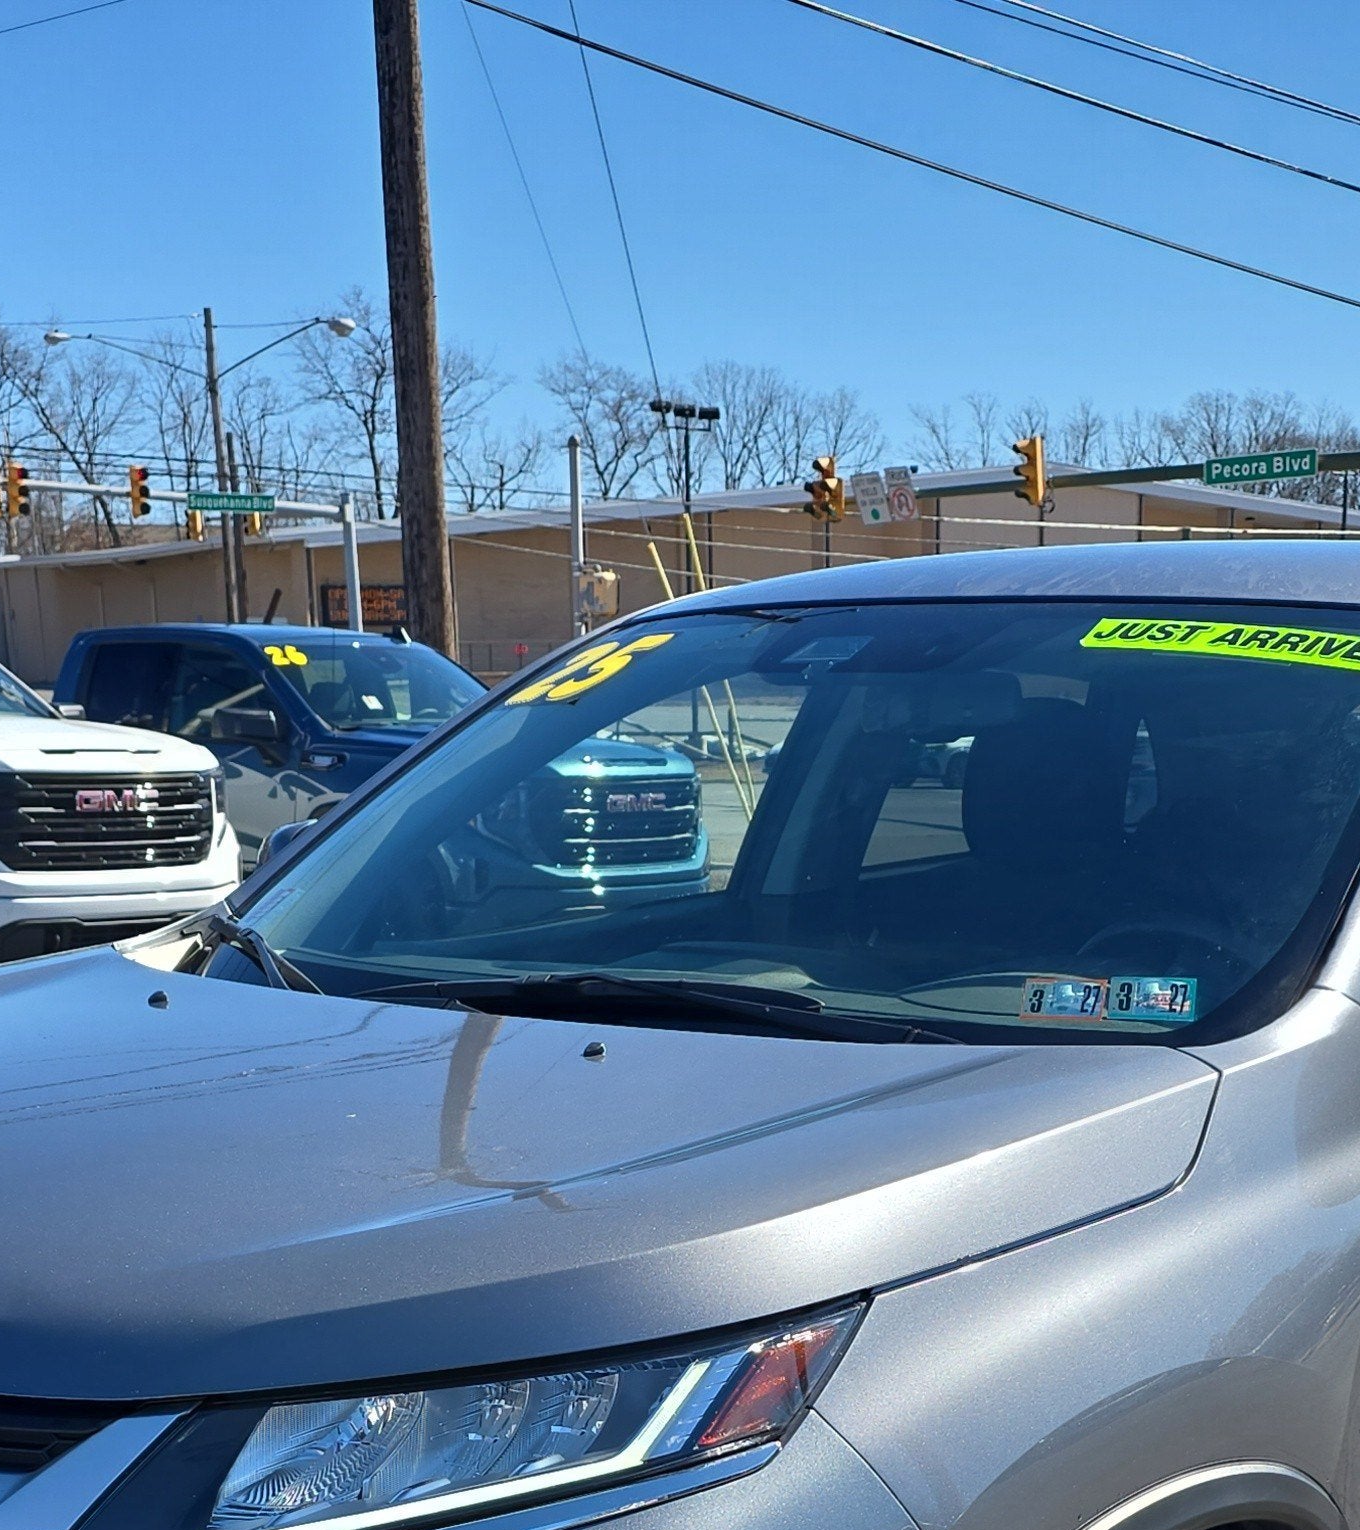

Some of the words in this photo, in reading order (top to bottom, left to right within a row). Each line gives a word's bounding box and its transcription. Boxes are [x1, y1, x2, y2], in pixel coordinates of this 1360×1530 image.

[1211, 461, 1267, 479] Pecora
[1272, 454, 1310, 473] Blvd
[190, 494, 252, 508] Susquehanna
[253, 497, 274, 509] Blvd
[1093, 621, 1213, 644] JUST
[264, 645, 308, 666] 26
[505, 633, 675, 706] 25
[75, 789, 159, 812] GMC
[606, 792, 667, 812] GMC
[1029, 989, 1045, 1013] 3
[1080, 984, 1101, 1016] 27
[1117, 982, 1133, 1012] 3
[1168, 983, 1189, 1015] 27
